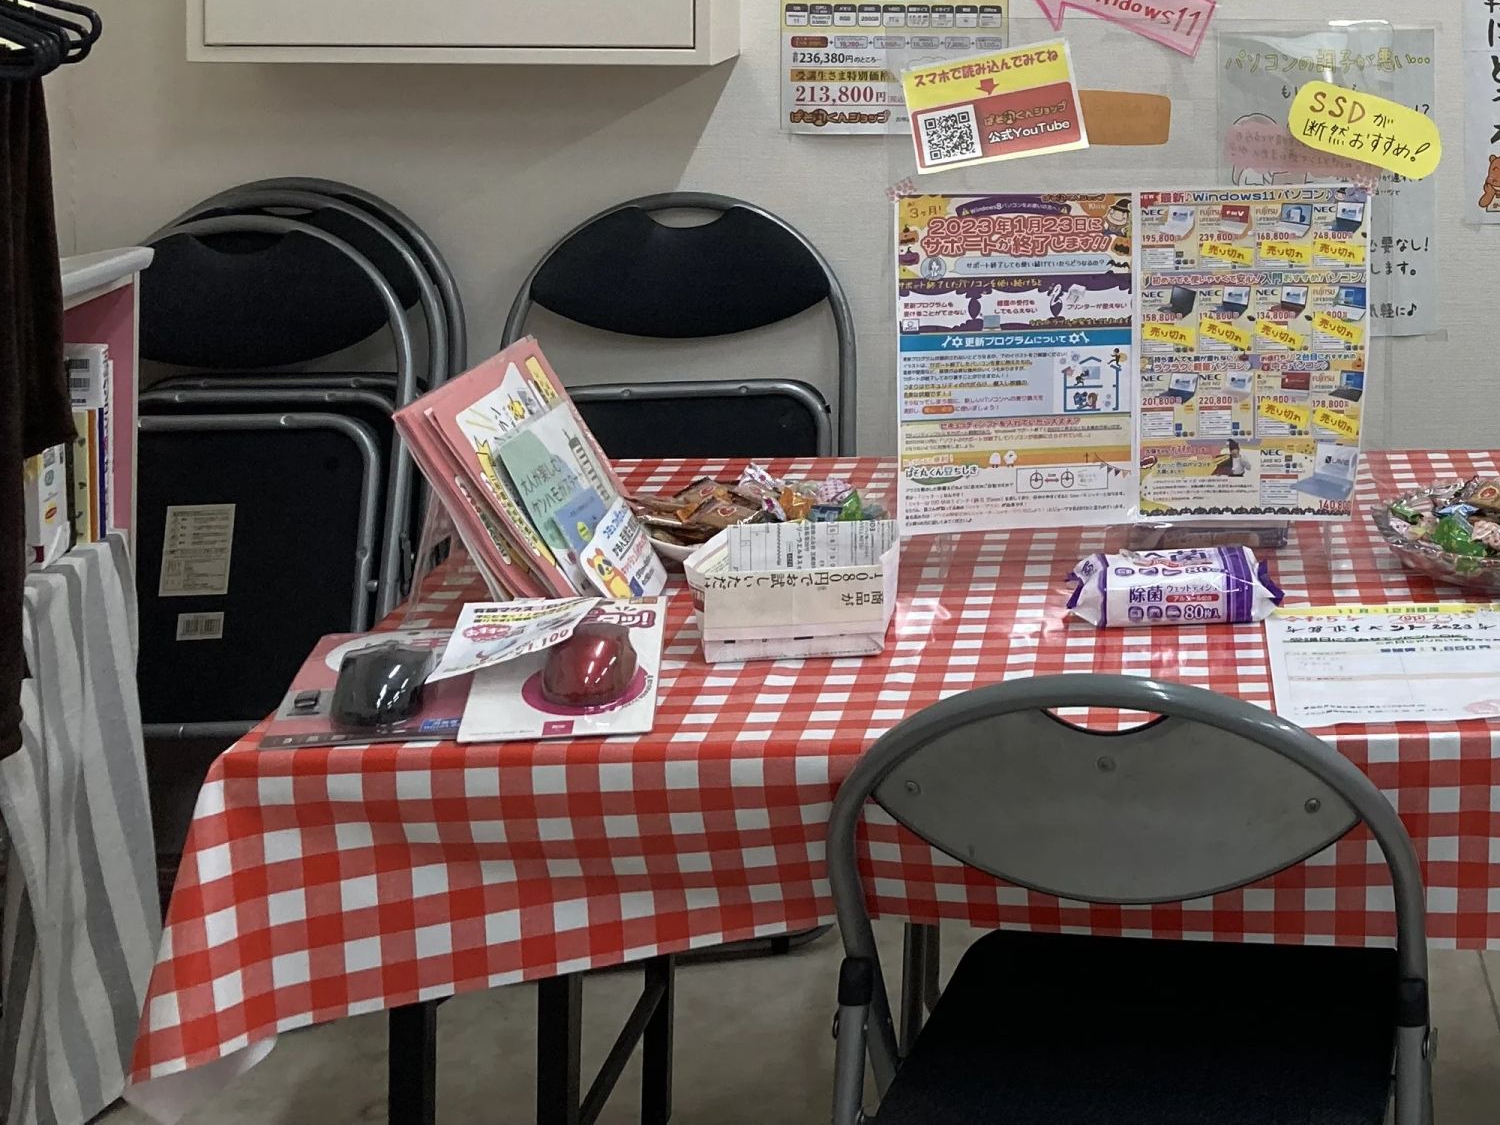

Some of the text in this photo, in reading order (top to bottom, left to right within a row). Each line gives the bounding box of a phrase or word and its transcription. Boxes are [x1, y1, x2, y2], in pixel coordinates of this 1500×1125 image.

[914, 49, 1059, 87] スマホで読み込んでみてね
[988, 119, 1070, 143] 公式YouTube
[1302, 120, 1431, 163] 断然おすすめ!
[1193, 191, 1275, 201] Windows11
[929, 218, 1101, 236] 2023年1月23日に
[1208, 244, 1244, 259] 売り切れ
[1266, 246, 1303, 259] 売り切れ
[1130, 586, 1162, 603] 除菌
